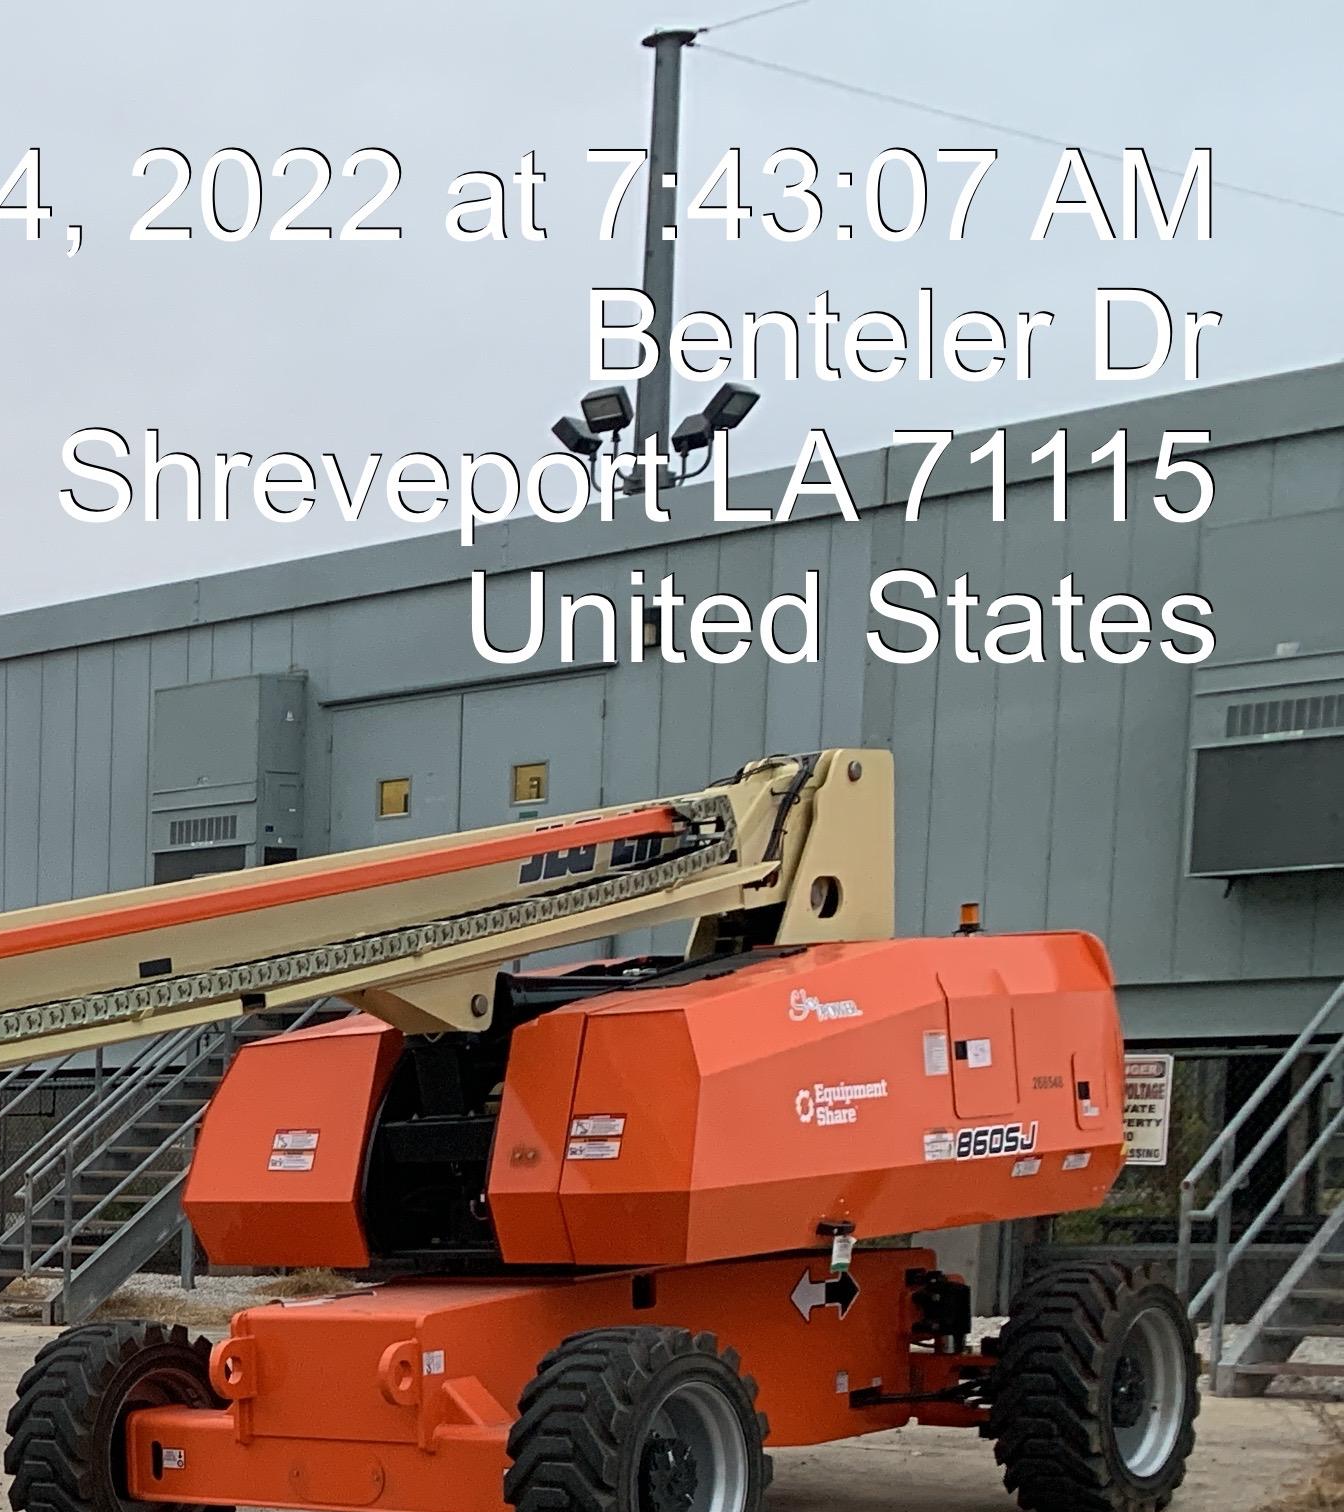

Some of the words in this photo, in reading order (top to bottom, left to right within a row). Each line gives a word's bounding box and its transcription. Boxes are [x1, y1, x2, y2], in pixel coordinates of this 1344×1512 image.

[813, 1079, 889, 1106] Equipment
[815, 1106, 858, 1127] Share
[956, 1121, 1039, 1160] 860SJ
